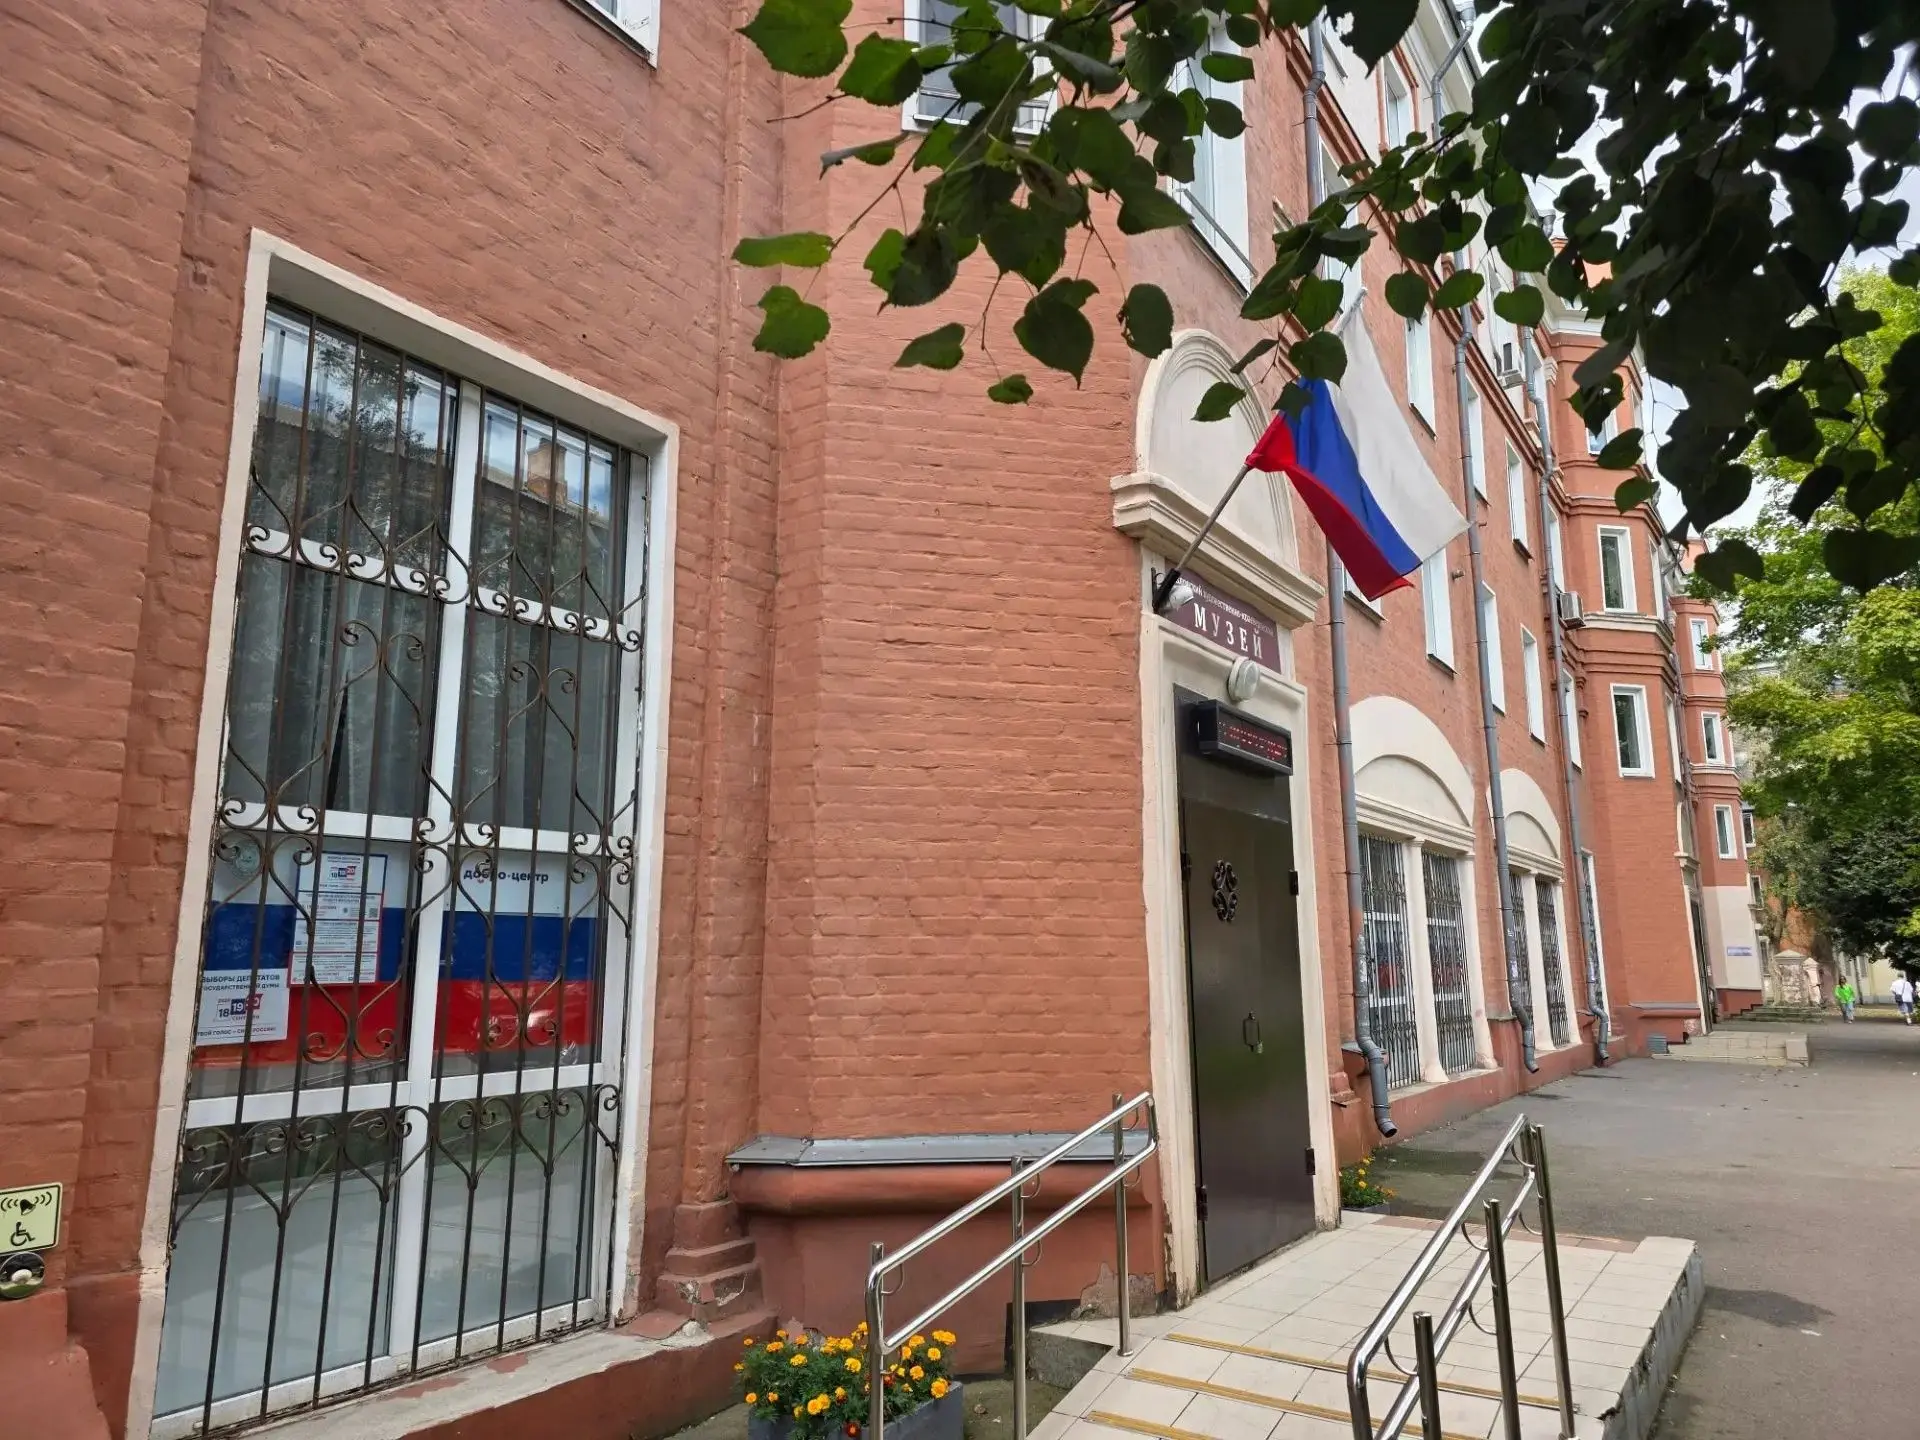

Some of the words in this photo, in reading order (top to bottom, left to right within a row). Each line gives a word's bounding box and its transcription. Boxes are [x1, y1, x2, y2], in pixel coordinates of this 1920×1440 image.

[1194, 602, 1263, 659] МУЗЕЙ
[236, 974, 280, 982] ДЕПТАТОВ
[219, 1008, 230, 1018] 18
[232, 1002, 244, 1012] 19
